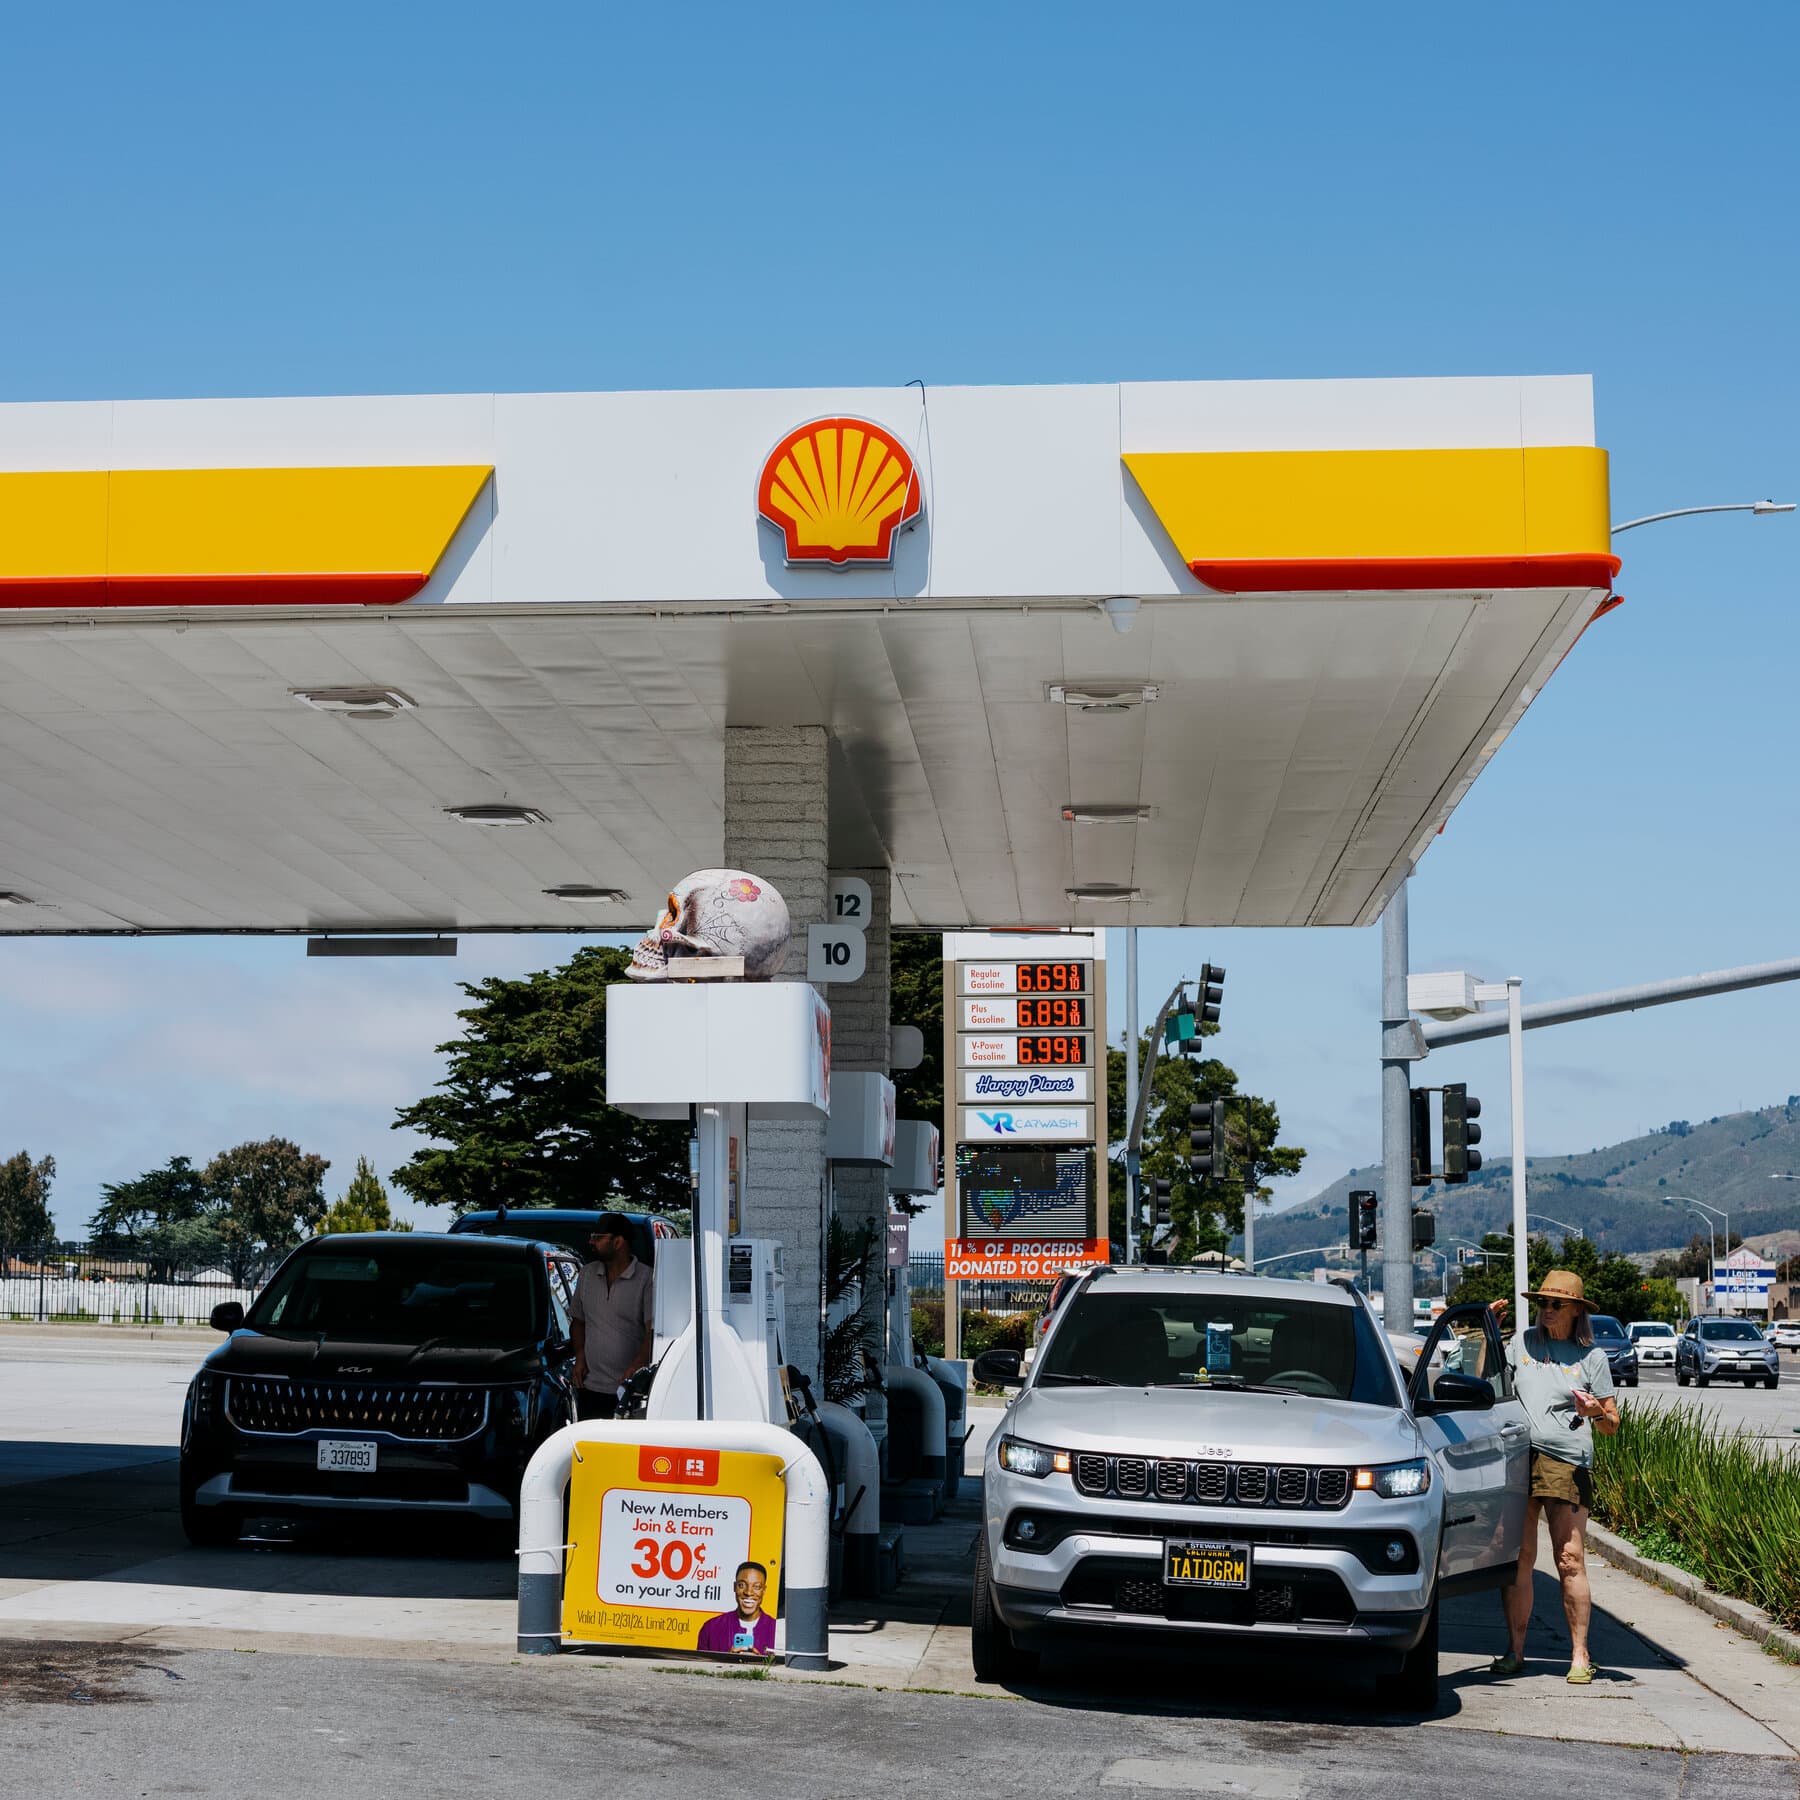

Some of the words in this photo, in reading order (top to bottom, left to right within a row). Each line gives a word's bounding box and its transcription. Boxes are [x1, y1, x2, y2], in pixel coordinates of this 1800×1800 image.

[834, 894, 861, 917] 12
[822, 942, 850, 966] 10
[970, 969, 1001, 980] Regular
[1017, 964, 1067, 992] 6.69
[970, 981, 1005, 989] Gasoline
[971, 1004, 987, 1014] Plus
[1017, 1000, 1067, 1027] 6.89
[971, 1015, 1006, 1024] Gasoline
[971, 1041, 1004, 1050] V-Power
[1018, 1037, 1068, 1064] 6.99
[971, 1052, 1006, 1061] Gasoline
[976, 1075, 1028, 1096] Hangry
[1028, 1075, 1074, 1094] Planet
[984, 1243, 1005, 1257] OF
[1011, 1242, 1084, 1257] PROCEEDS
[949, 1260, 1017, 1275] DONATED
[1020, 1260, 1039, 1275] TO
[330, 1449, 370, 1466] 337893
[1197, 1445, 1233, 1457] Jeep
[620, 1500, 656, 1516] New
[660, 1502, 729, 1520] Members
[632, 1518, 661, 1533] Join
[664, 1519, 677, 1534] &
[681, 1521, 714, 1536] Earn
[1171, 1557, 1244, 1583] TATDGRM
[616, 1584, 634, 1595] on
[638, 1584, 672, 1599] your
[675, 1584, 700, 1600] 3rd
[703, 1585, 721, 1601] fill
[577, 1610, 596, 1625] Valid
[645, 1615, 666, 1630] Limit
[666, 1617, 678, 1632] 20
